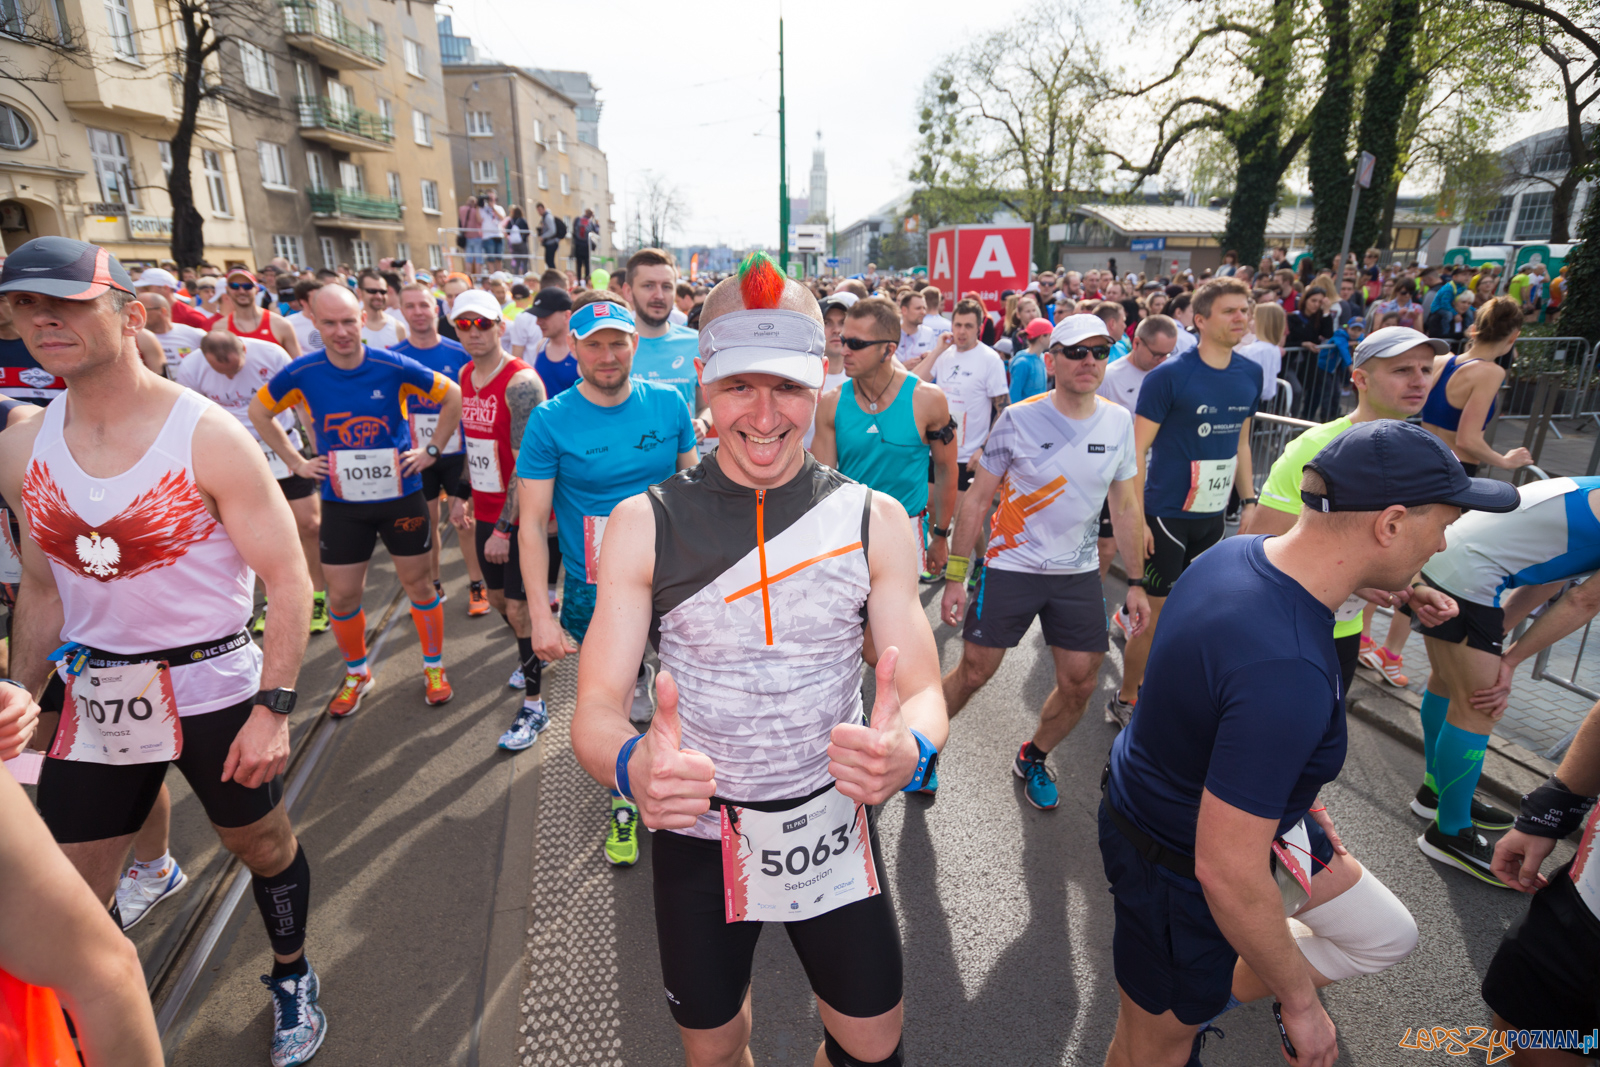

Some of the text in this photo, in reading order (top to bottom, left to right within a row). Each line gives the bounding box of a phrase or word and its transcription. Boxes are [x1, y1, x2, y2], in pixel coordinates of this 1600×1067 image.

[933, 237, 951, 280] A
[969, 234, 1016, 280] A
[585, 446, 609, 455] ARTUR
[343, 465, 393, 481] 10182
[204, 635, 247, 657] ICEBUG
[1531, 815, 1558, 828] move
[1544, 813, 1561, 823] the
[1549, 808, 1563, 816] on
[760, 823, 849, 877] 5063
[784, 867, 833, 891] Sebastian
